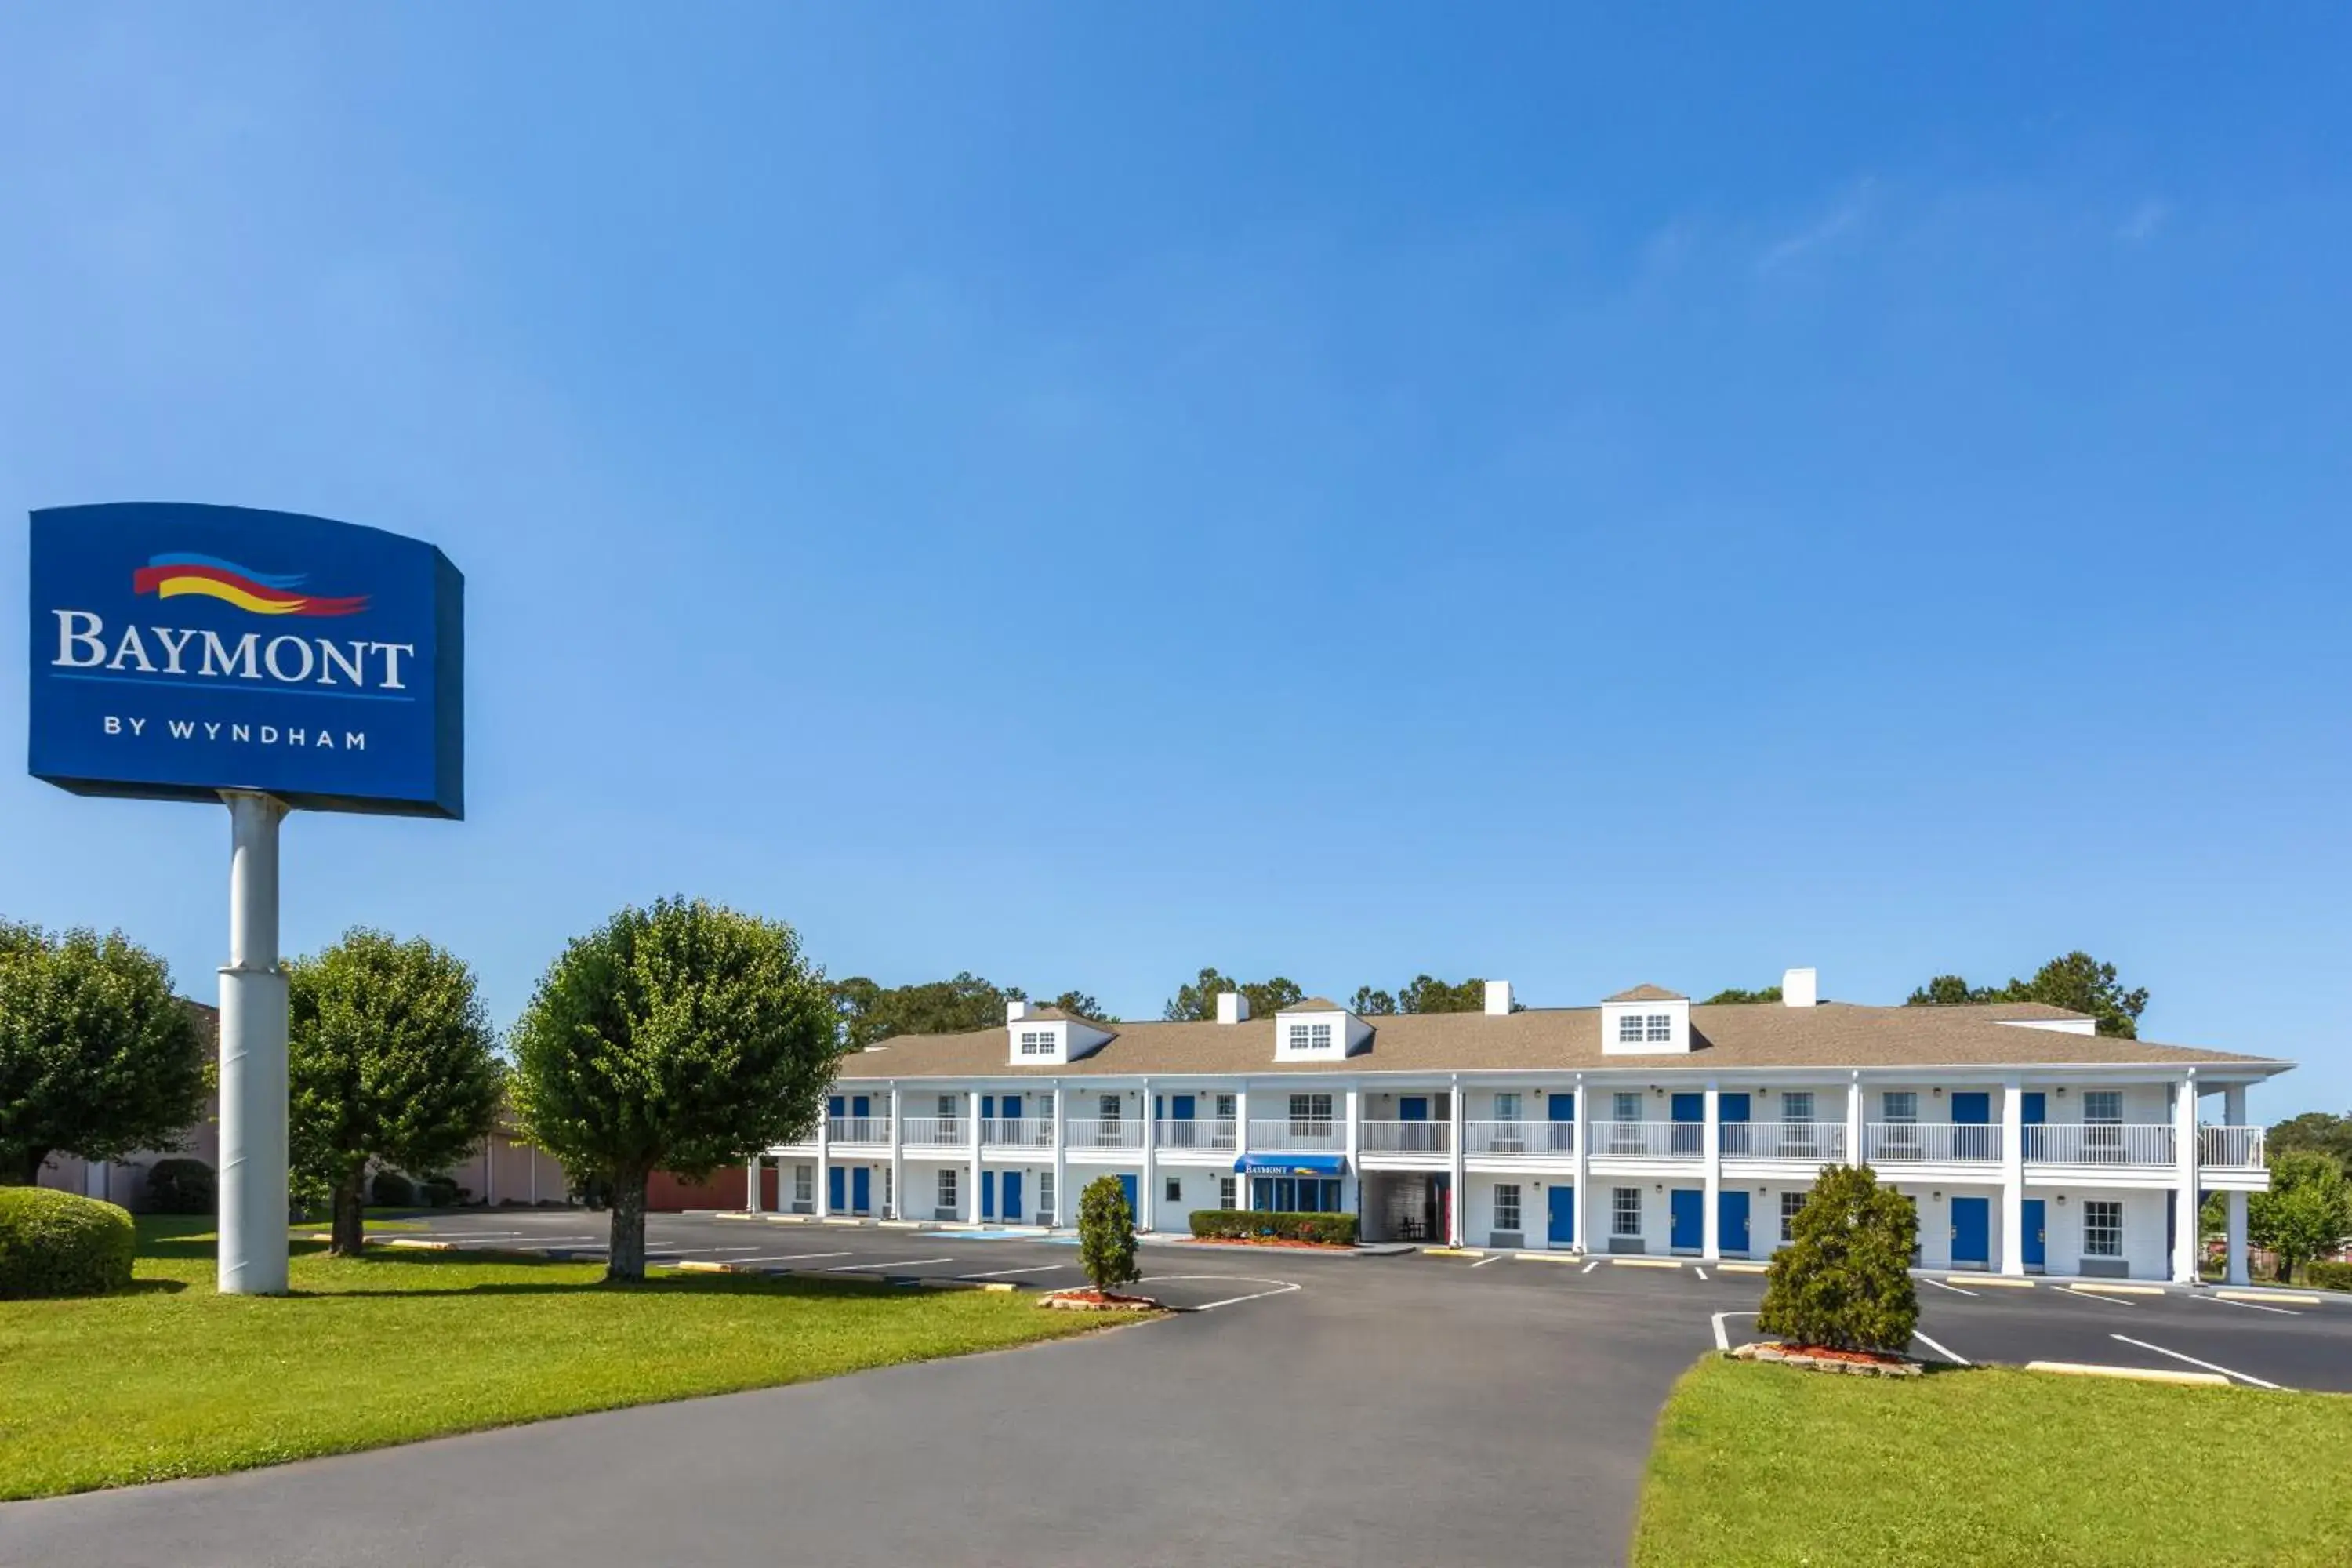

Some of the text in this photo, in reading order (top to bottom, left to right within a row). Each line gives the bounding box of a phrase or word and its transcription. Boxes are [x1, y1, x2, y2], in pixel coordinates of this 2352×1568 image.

[52, 609, 414, 688] BAYMONT
[104, 716, 365, 750] BY WYNDHAM
[1246, 1166, 1287, 1174] BAYMONT
